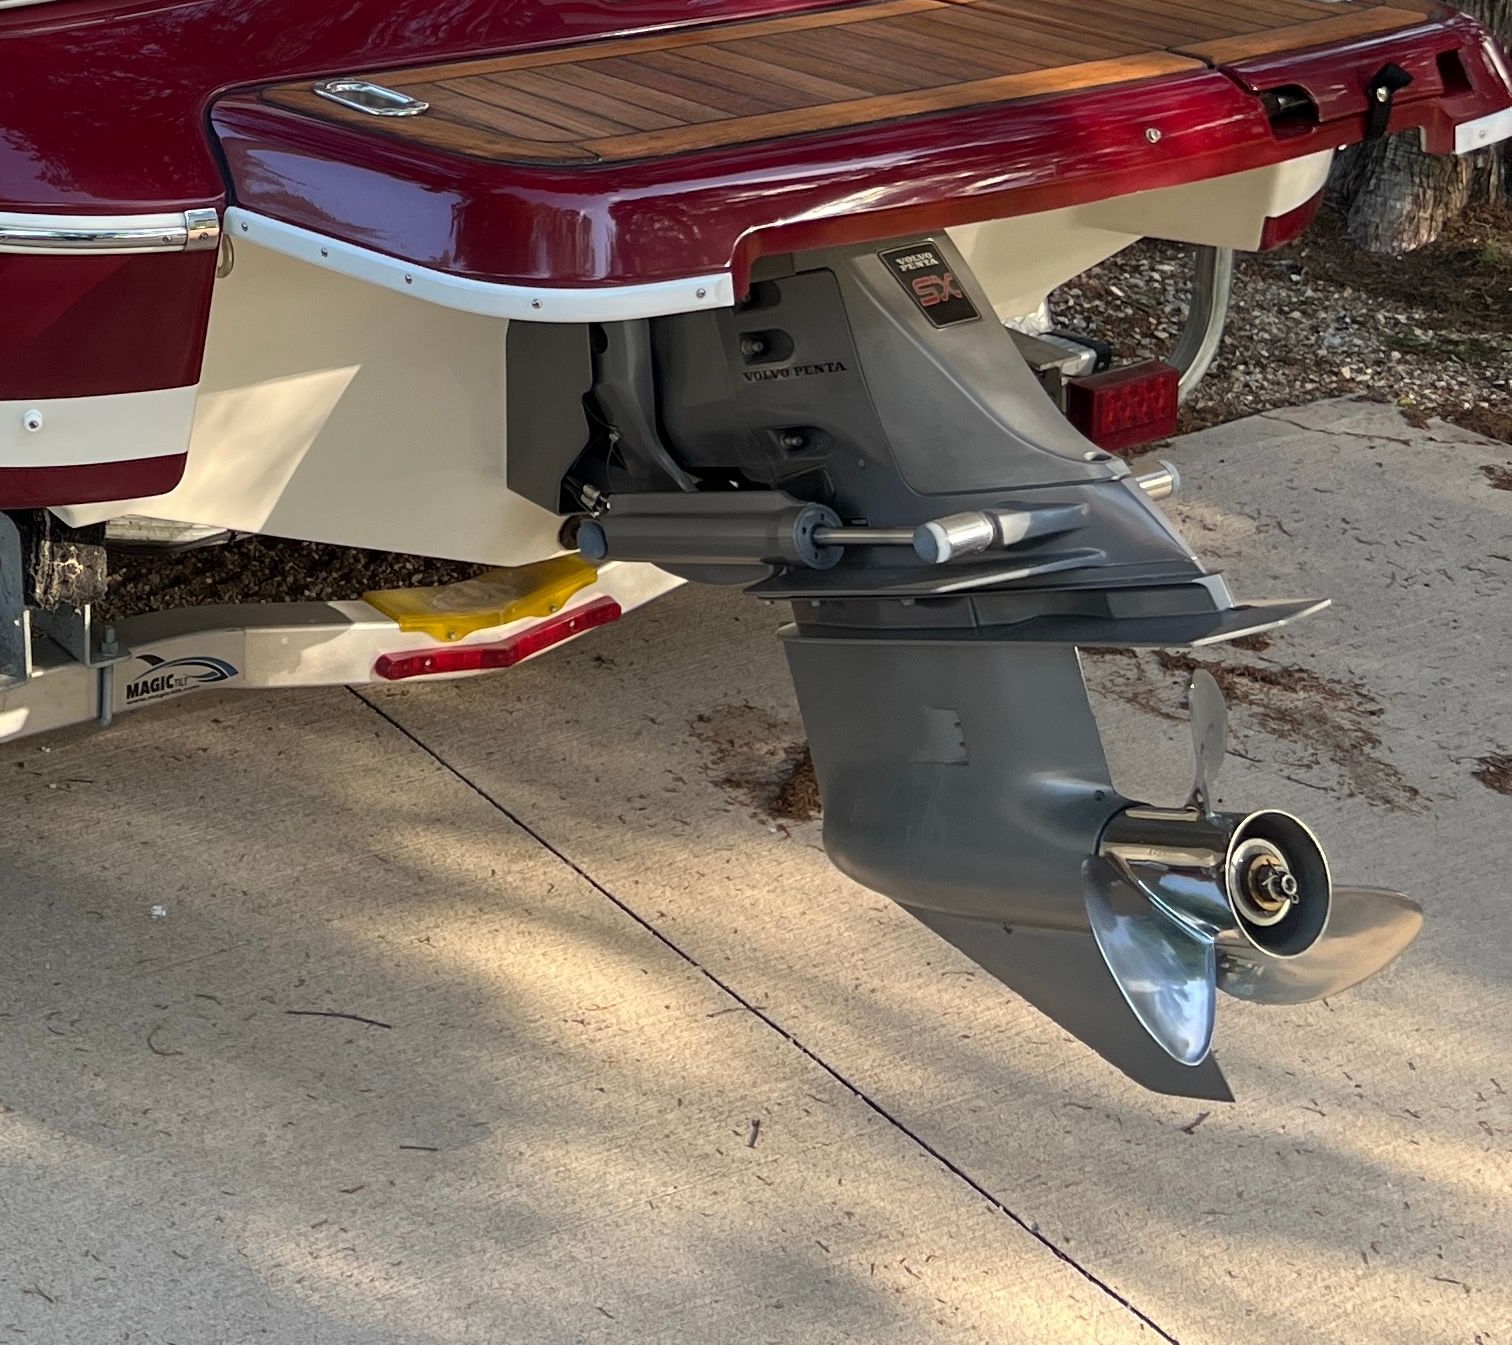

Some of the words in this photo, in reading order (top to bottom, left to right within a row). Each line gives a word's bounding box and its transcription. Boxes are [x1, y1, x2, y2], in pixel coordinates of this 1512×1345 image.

[895, 252, 933, 265] VOLVO
[898, 258, 940, 272] PENTA
[911, 272, 963, 307] SX
[742, 367, 790, 382] VOLVO
[793, 361, 849, 377] PENTA
[126, 673, 174, 700] MAGIC
